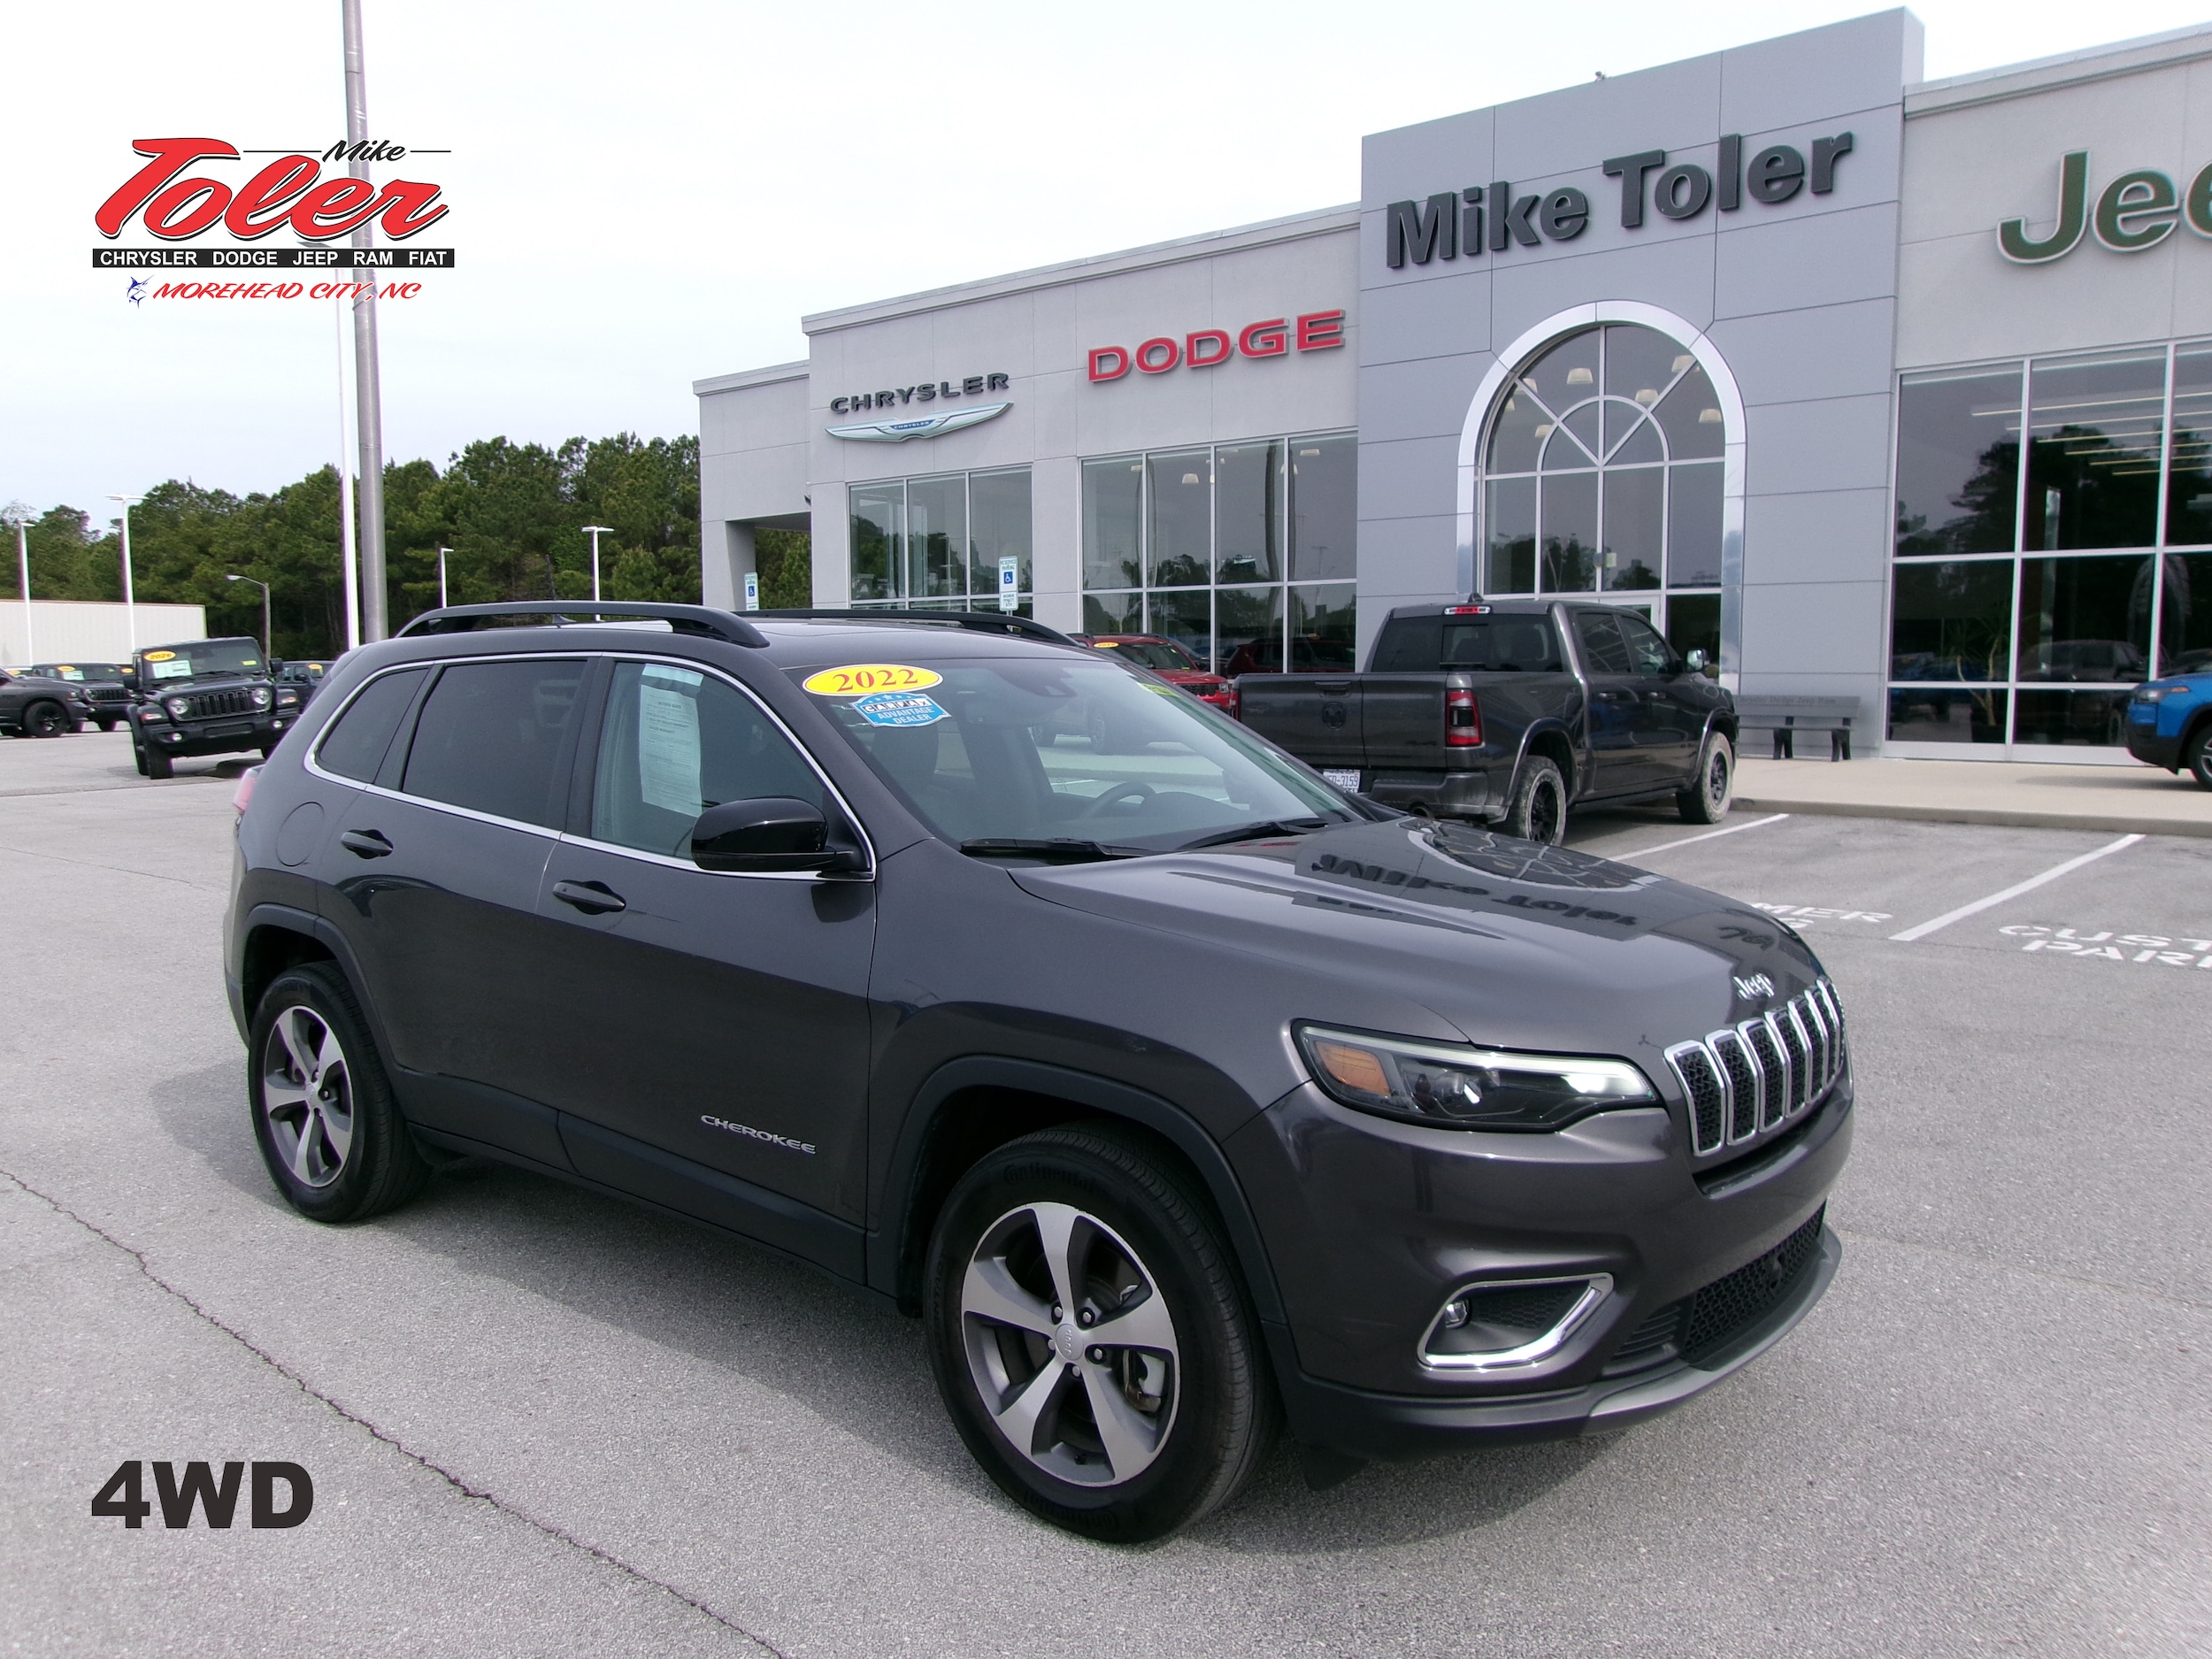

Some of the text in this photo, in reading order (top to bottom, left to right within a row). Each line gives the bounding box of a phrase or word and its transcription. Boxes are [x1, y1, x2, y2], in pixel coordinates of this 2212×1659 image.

[1386, 132, 1853, 269] Mike Toler
[1087, 308, 1346, 384] DODGE
[830, 373, 1010, 414] CHRYSLER
[894, 420, 930, 430] CHRYSLER
[833, 669, 918, 693] 2022
[863, 698, 932, 713] CARFAX
[878, 707, 935, 719] ADVANTAGE
[893, 714, 932, 725] DEALER
[1732, 972, 1775, 1000] Jeep
[701, 1114, 817, 1155] CHEROKEE
